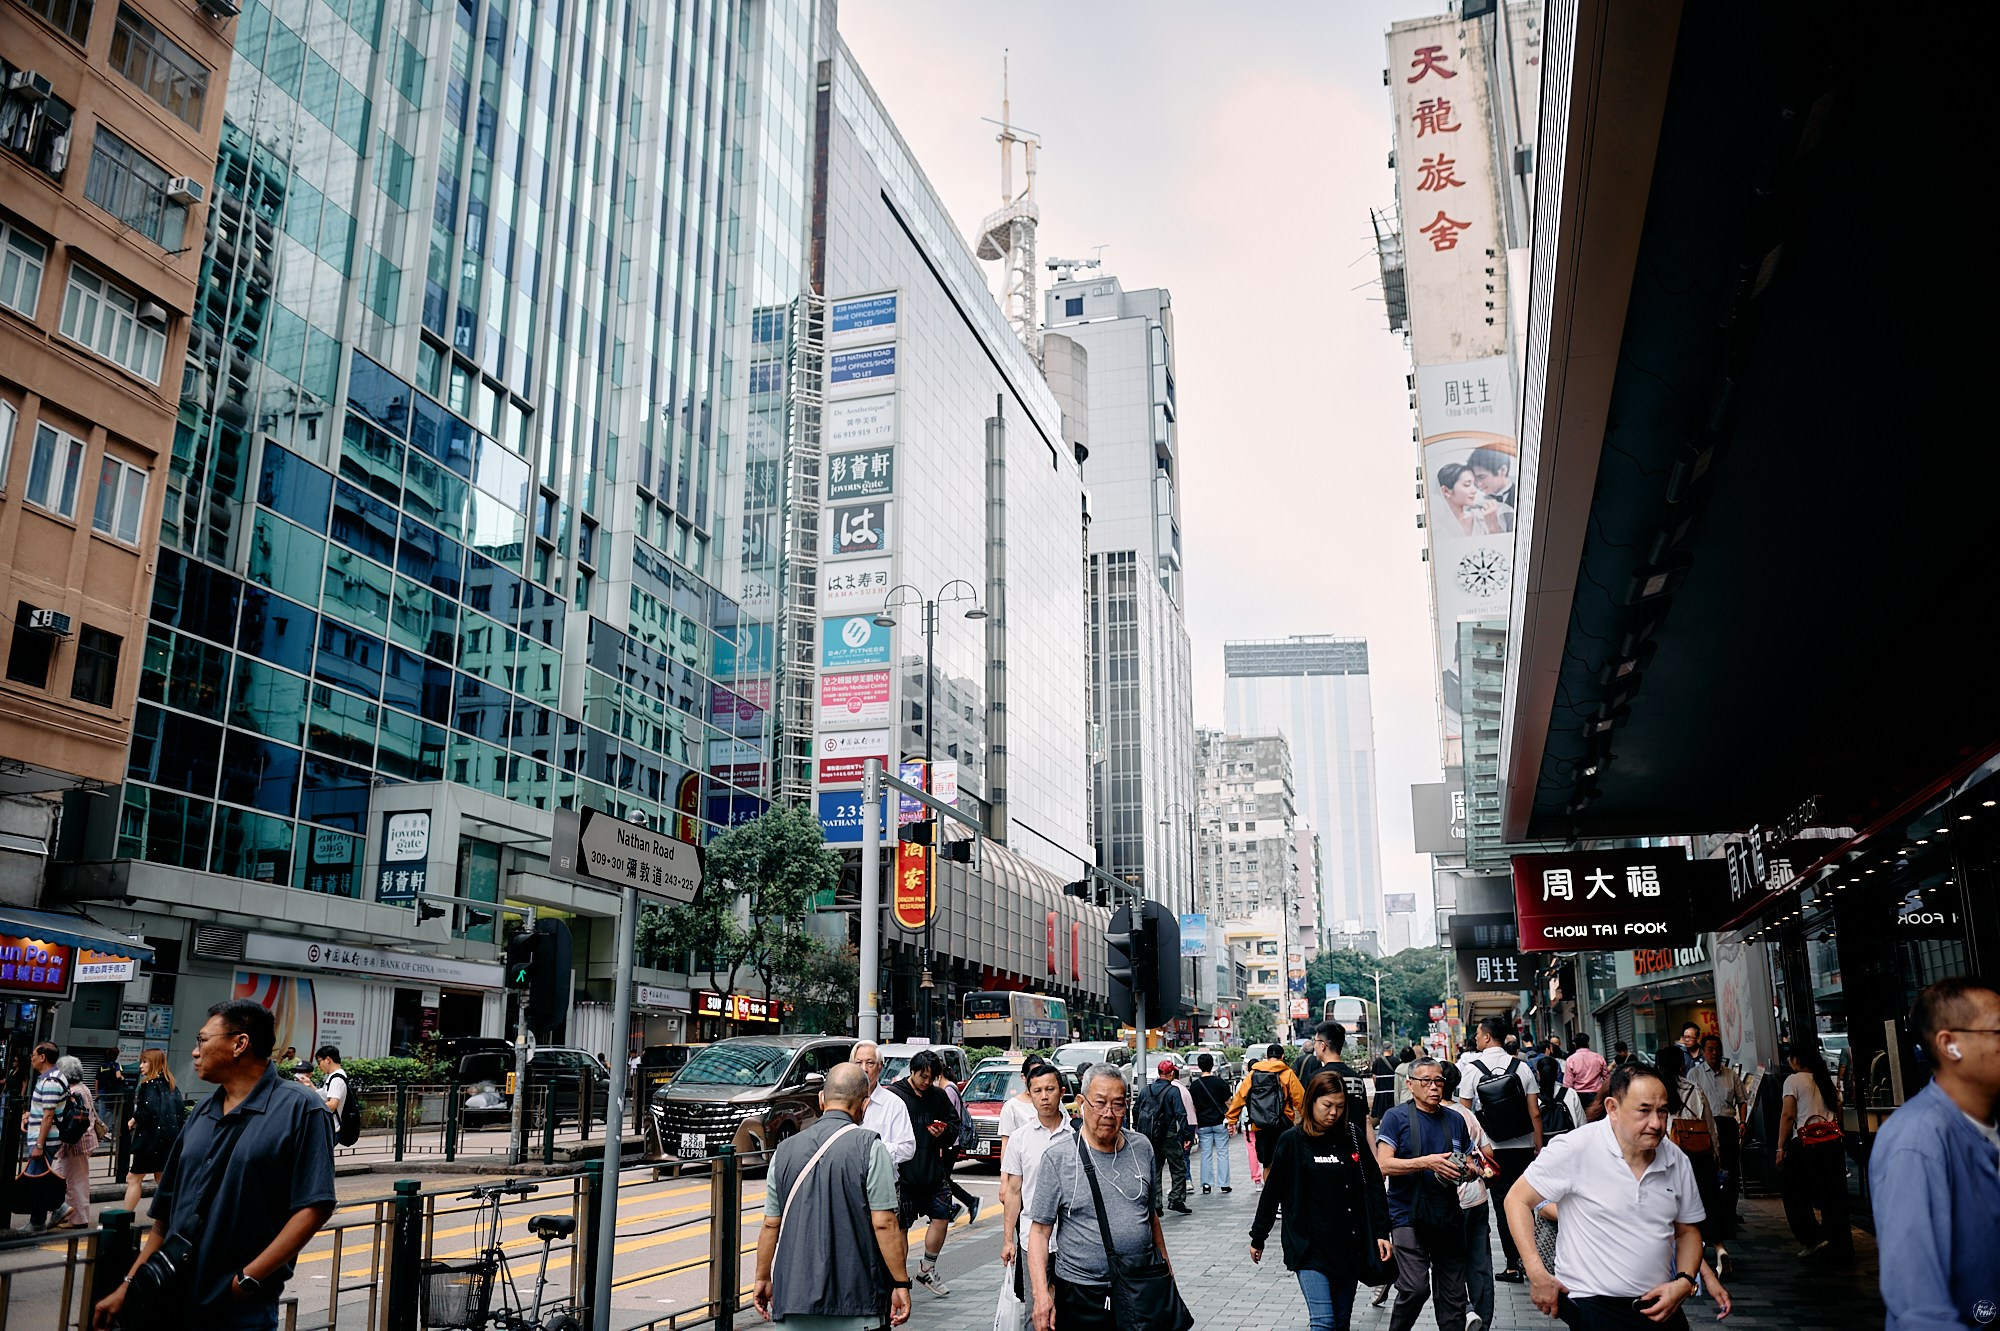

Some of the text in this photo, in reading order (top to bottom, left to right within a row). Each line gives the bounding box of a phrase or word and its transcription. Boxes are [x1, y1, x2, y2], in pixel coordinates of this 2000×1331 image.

[1407, 45, 1472, 252] 天龍旅舍
[848, 301, 873, 310] NATHAN
[873, 298, 892, 306] ROAD
[847, 352, 872, 361] NATHAN
[852, 371, 861, 379] TO
[1445, 377, 1491, 406] 周生生
[843, 430, 856, 438] 919
[857, 428, 871, 436] 919
[831, 452, 890, 483] 彩薈軒
[840, 507, 878, 546] は
[828, 571, 887, 591] はま寿司
[828, 587, 888, 599] HAMA-SUSHI
[828, 649, 847, 657] 24/7
[850, 646, 885, 654] FITNESS
[822, 819, 856, 827] NATHAN
[391, 829, 425, 841] joyous
[395, 838, 421, 855] gate
[617, 828, 675, 860] Nathan Road
[626, 857, 663, 886] 彌敦道
[381, 870, 425, 893] 彩薈軒
[1542, 865, 1661, 901] 周大福
[1543, 922, 1668, 938] CHOW TAI FOOK
[25, 945, 48, 964] Po
[82, 964, 127, 975] 香港必買手信店
[380, 958, 400, 970] BANK
[401, 961, 411, 971] OF
[412, 963, 435, 974] CHINA
[1476, 956, 1519, 983] 周生生
